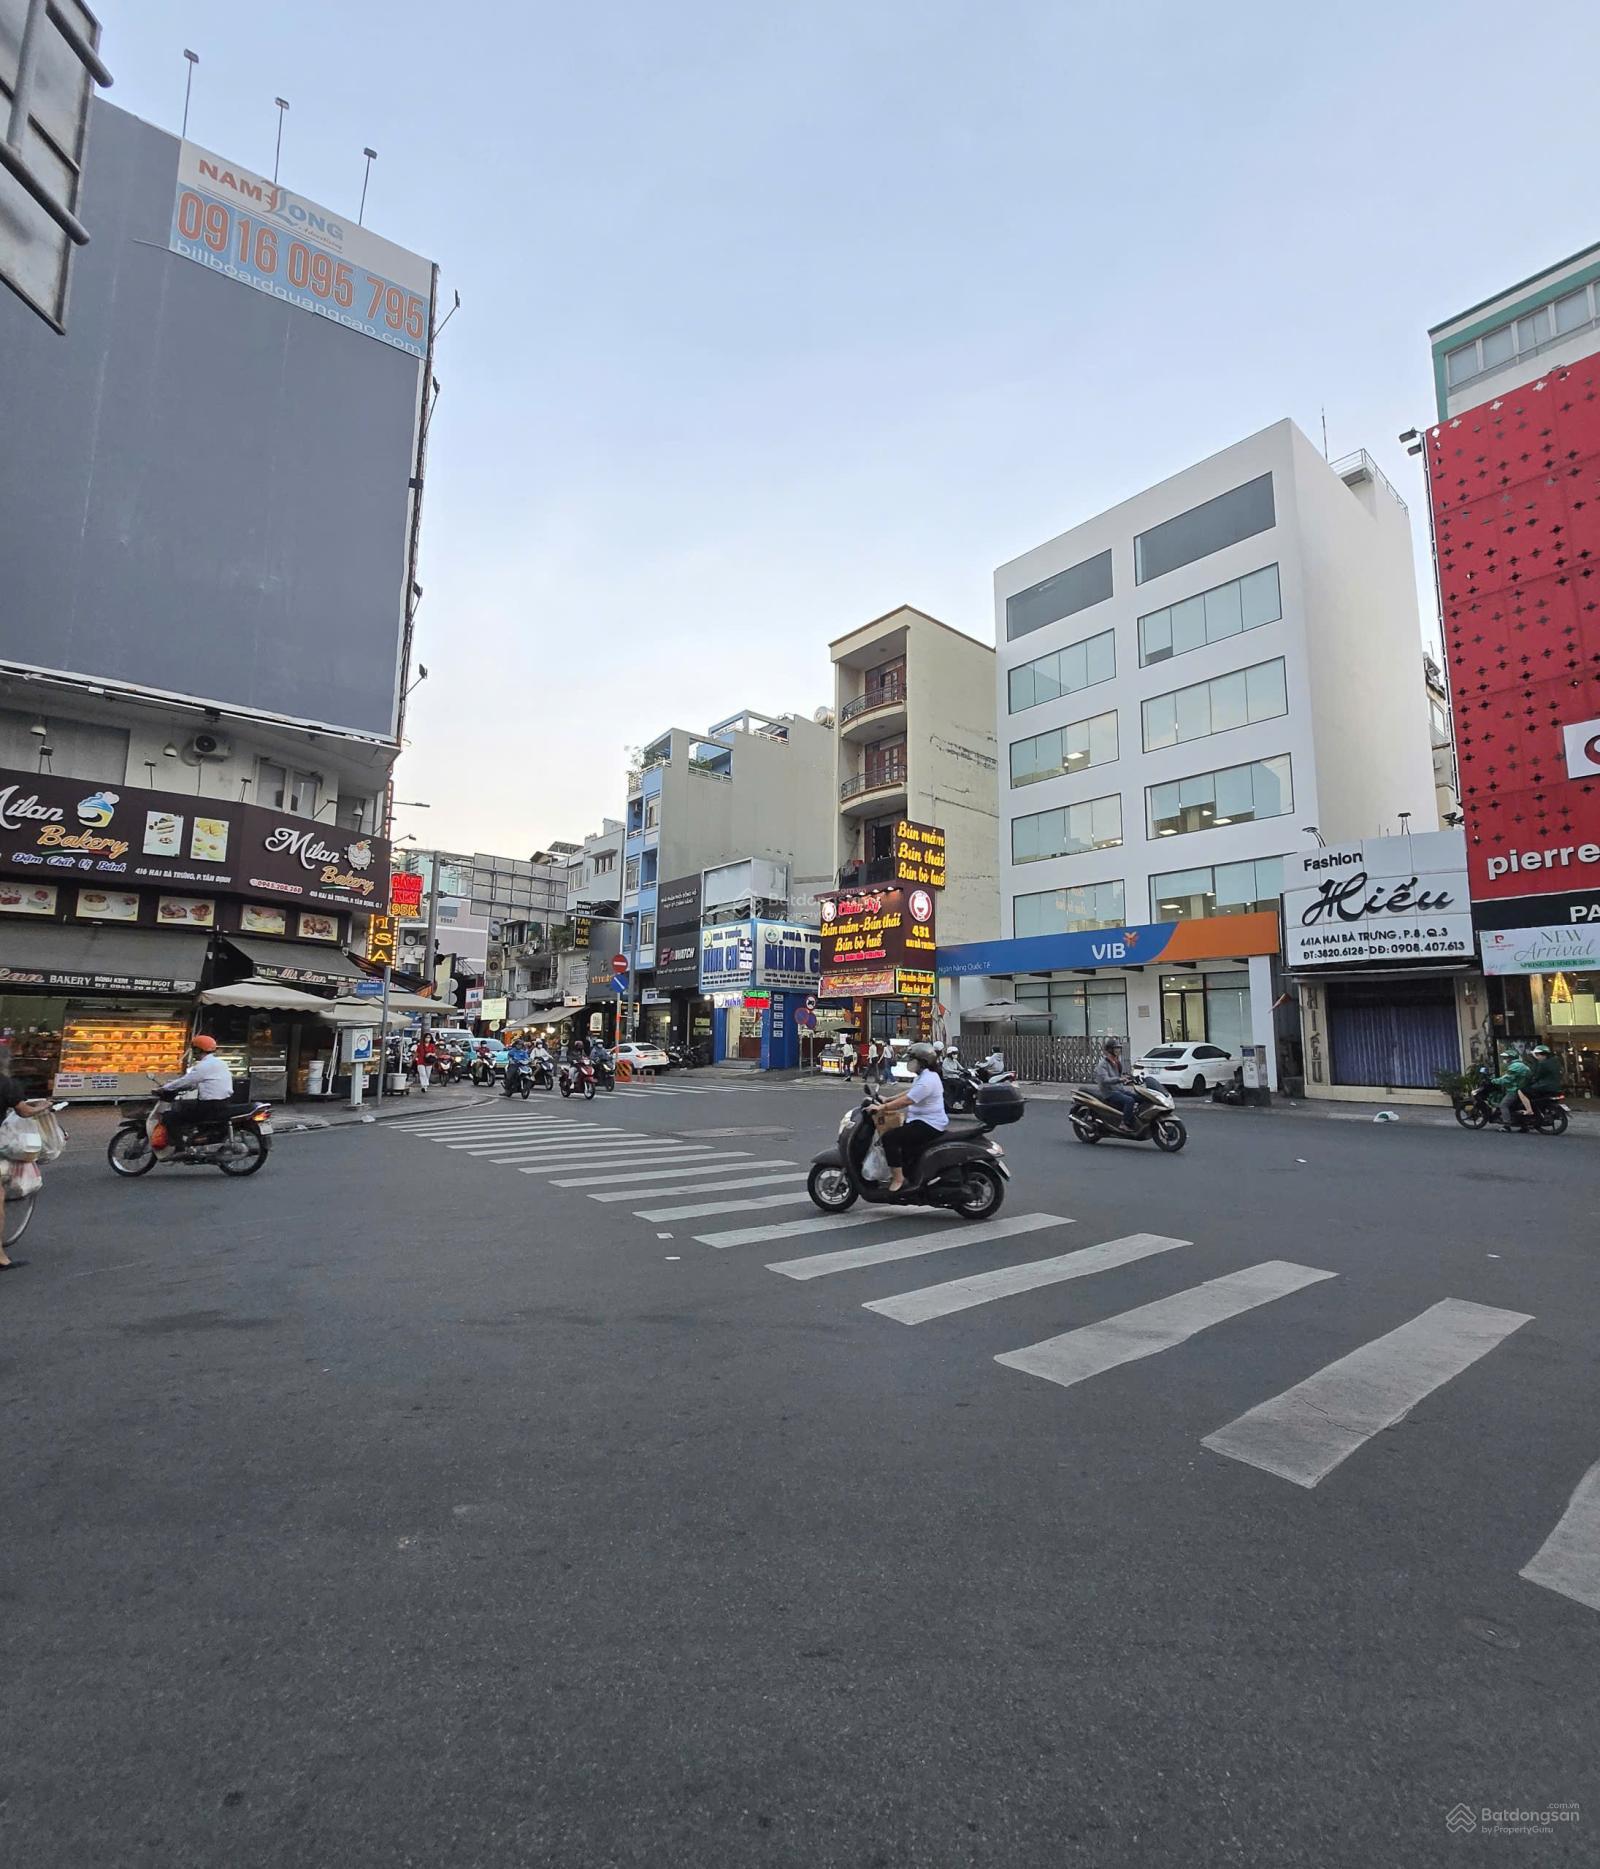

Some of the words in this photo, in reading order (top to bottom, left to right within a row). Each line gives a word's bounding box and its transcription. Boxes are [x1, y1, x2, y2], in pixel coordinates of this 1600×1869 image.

[199, 159, 262, 202] NAM
[178, 191, 279, 274] 0916
[286, 241, 354, 309] 095
[365, 275, 424, 341] 795
[37, 824, 129, 859] Bakery
[897, 820, 920, 842] Bún
[920, 828, 946, 848] mắm
[265, 827, 341, 870] Milan
[897, 842, 923, 863] Bún
[923, 849, 946, 867] thái
[897, 861, 918, 882] Bún
[918, 866, 930, 884] bò
[930, 869, 946, 887] huế
[1487, 843, 1600, 881] pierre
[320, 865, 375, 896] Bakery
[391, 902, 419, 917] 95K
[820, 922, 838, 937] Bún
[882, 912, 902, 929] thái
[911, 924, 930, 939] 431
[1299, 936, 1322, 947] 441A
[1322, 934, 1341, 946] HAI
[1341, 931, 1357, 944] BÀ
[1426, 927, 1449, 939] Q.3
[1541, 929, 1583, 944] NEW
[834, 937, 853, 952] Bún
[853, 935, 866, 950] bò
[866, 930, 884, 948] huế
[1091, 942, 1127, 961] VIB
[1513, 939, 1595, 962] Arrival
[809, 948, 821, 974] C
[49, 973, 92, 987] BAKERY
